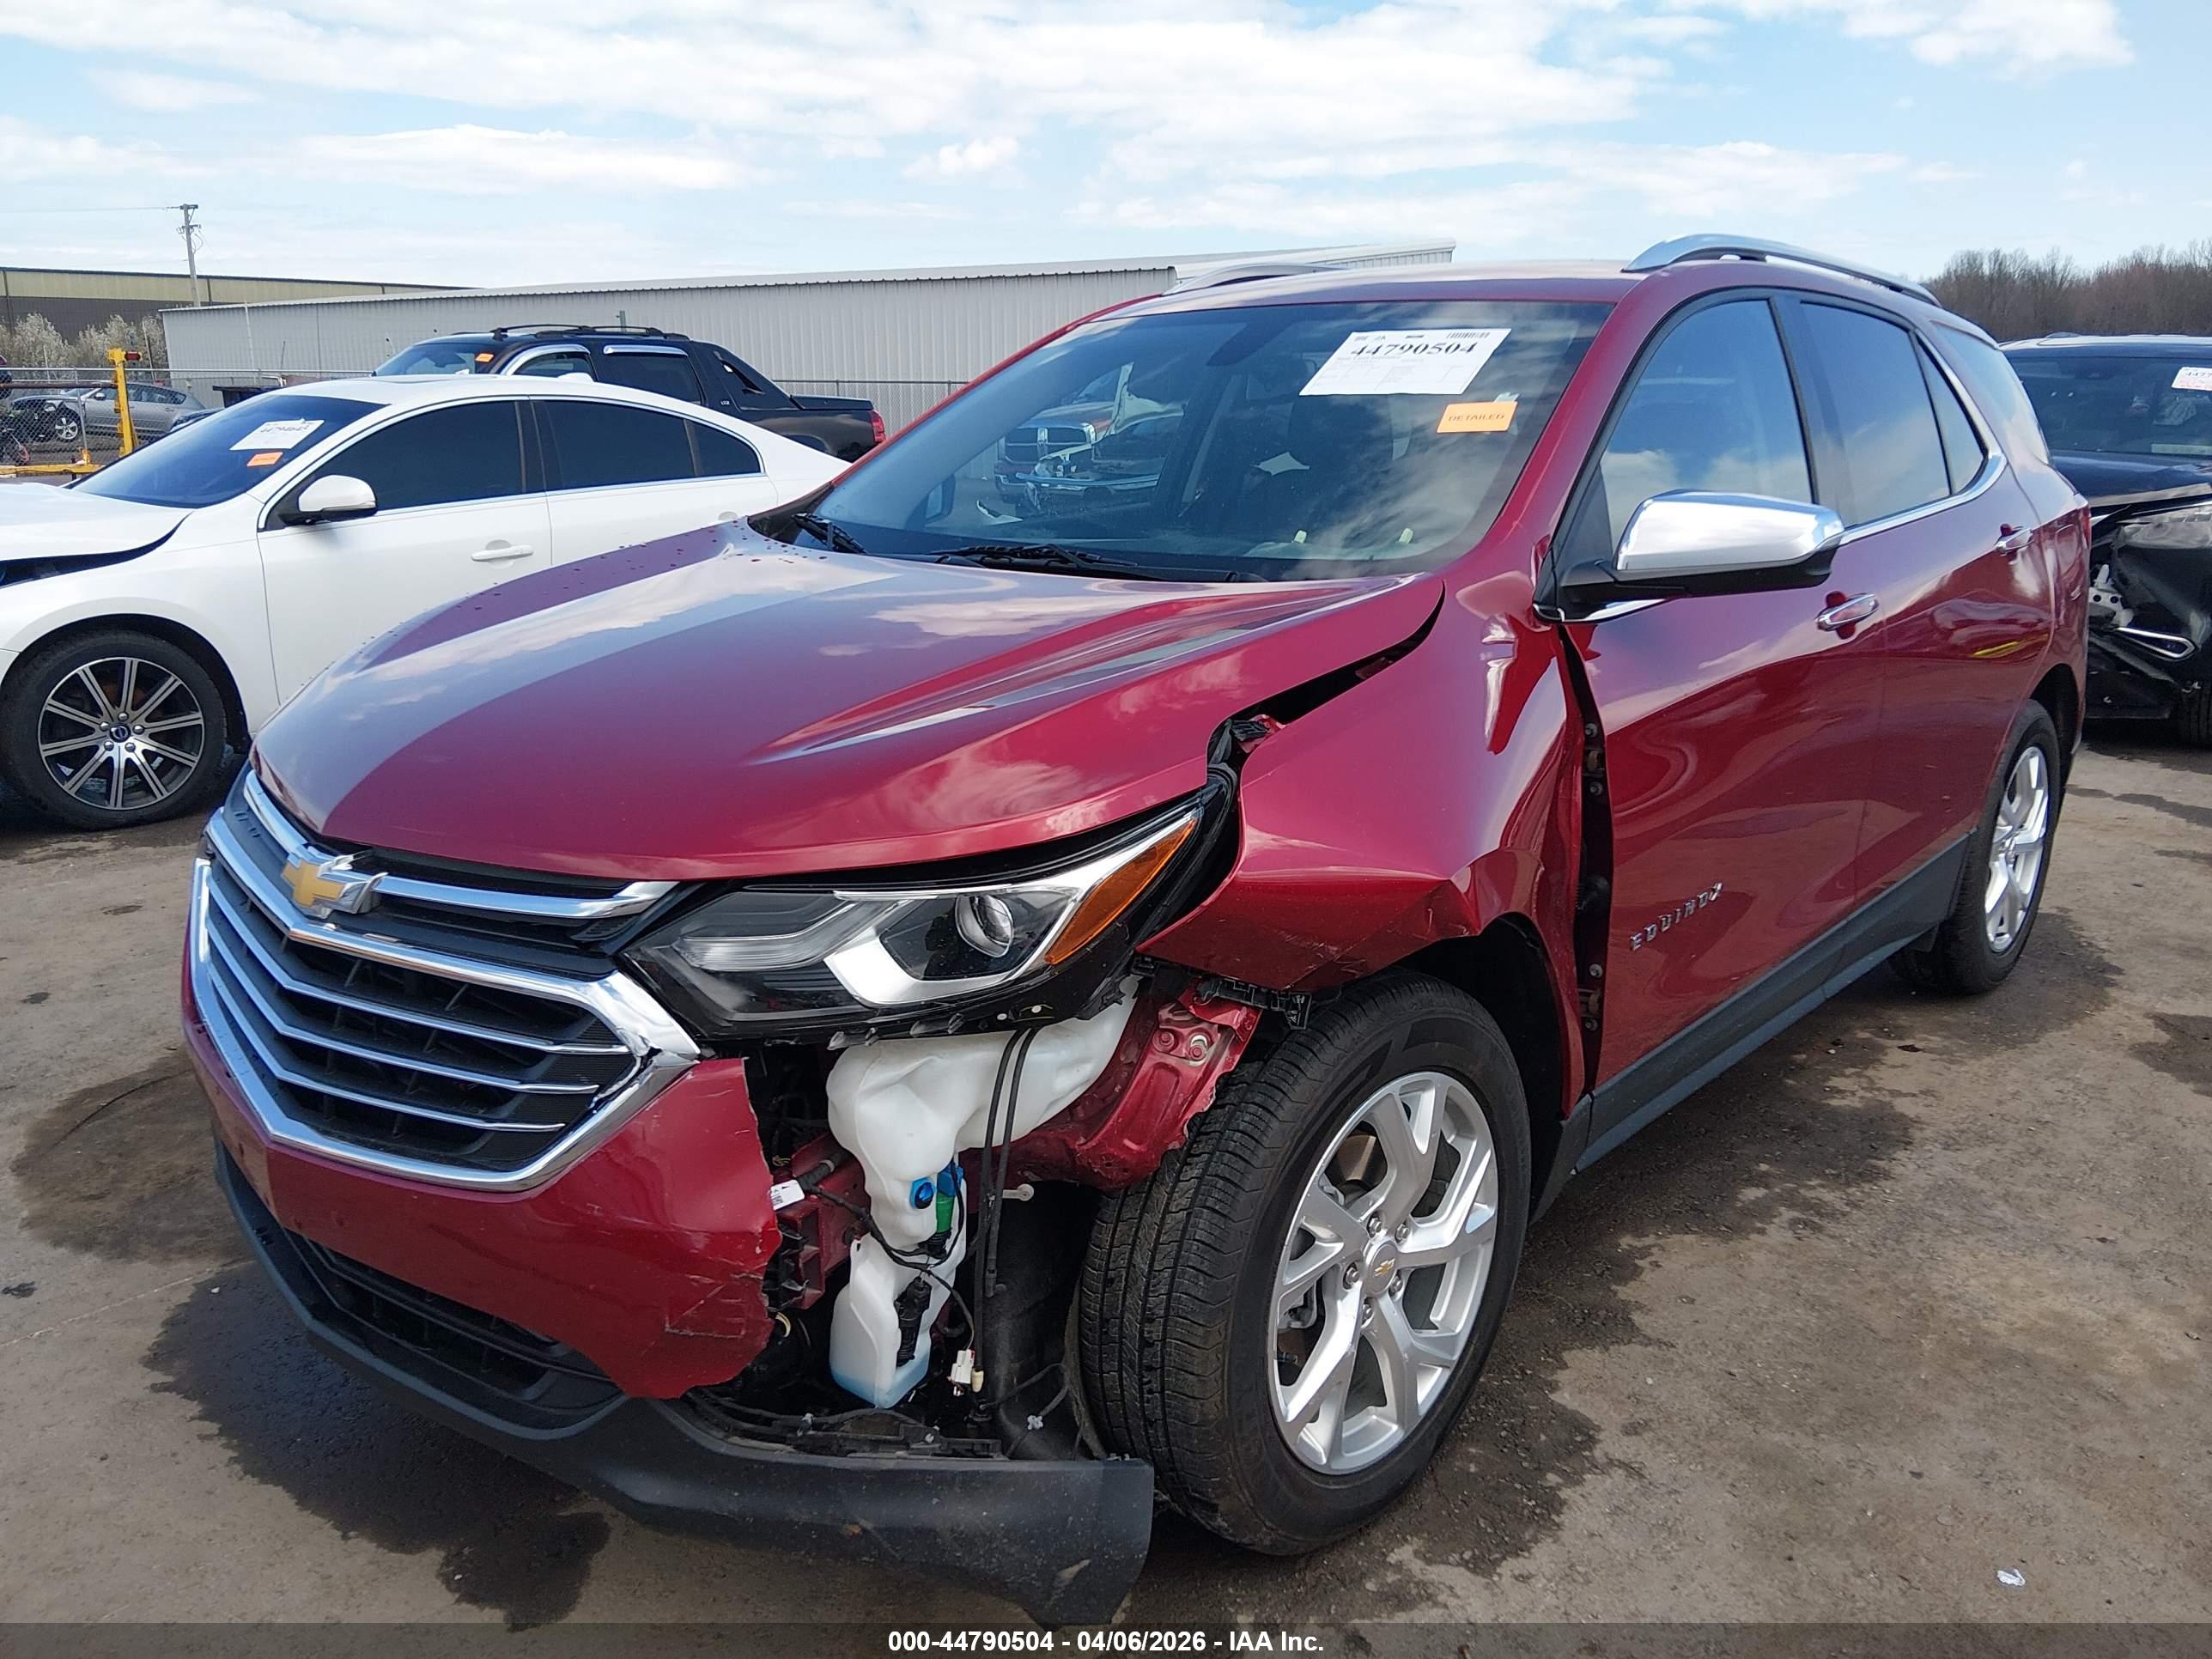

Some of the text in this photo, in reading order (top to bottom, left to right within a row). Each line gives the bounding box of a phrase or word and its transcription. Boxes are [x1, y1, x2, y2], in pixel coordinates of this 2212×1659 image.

[1351, 342, 1478, 356] 44790504
[1448, 412, 1505, 422] DETAILED
[1630, 882, 1723, 951] EQUINOX
